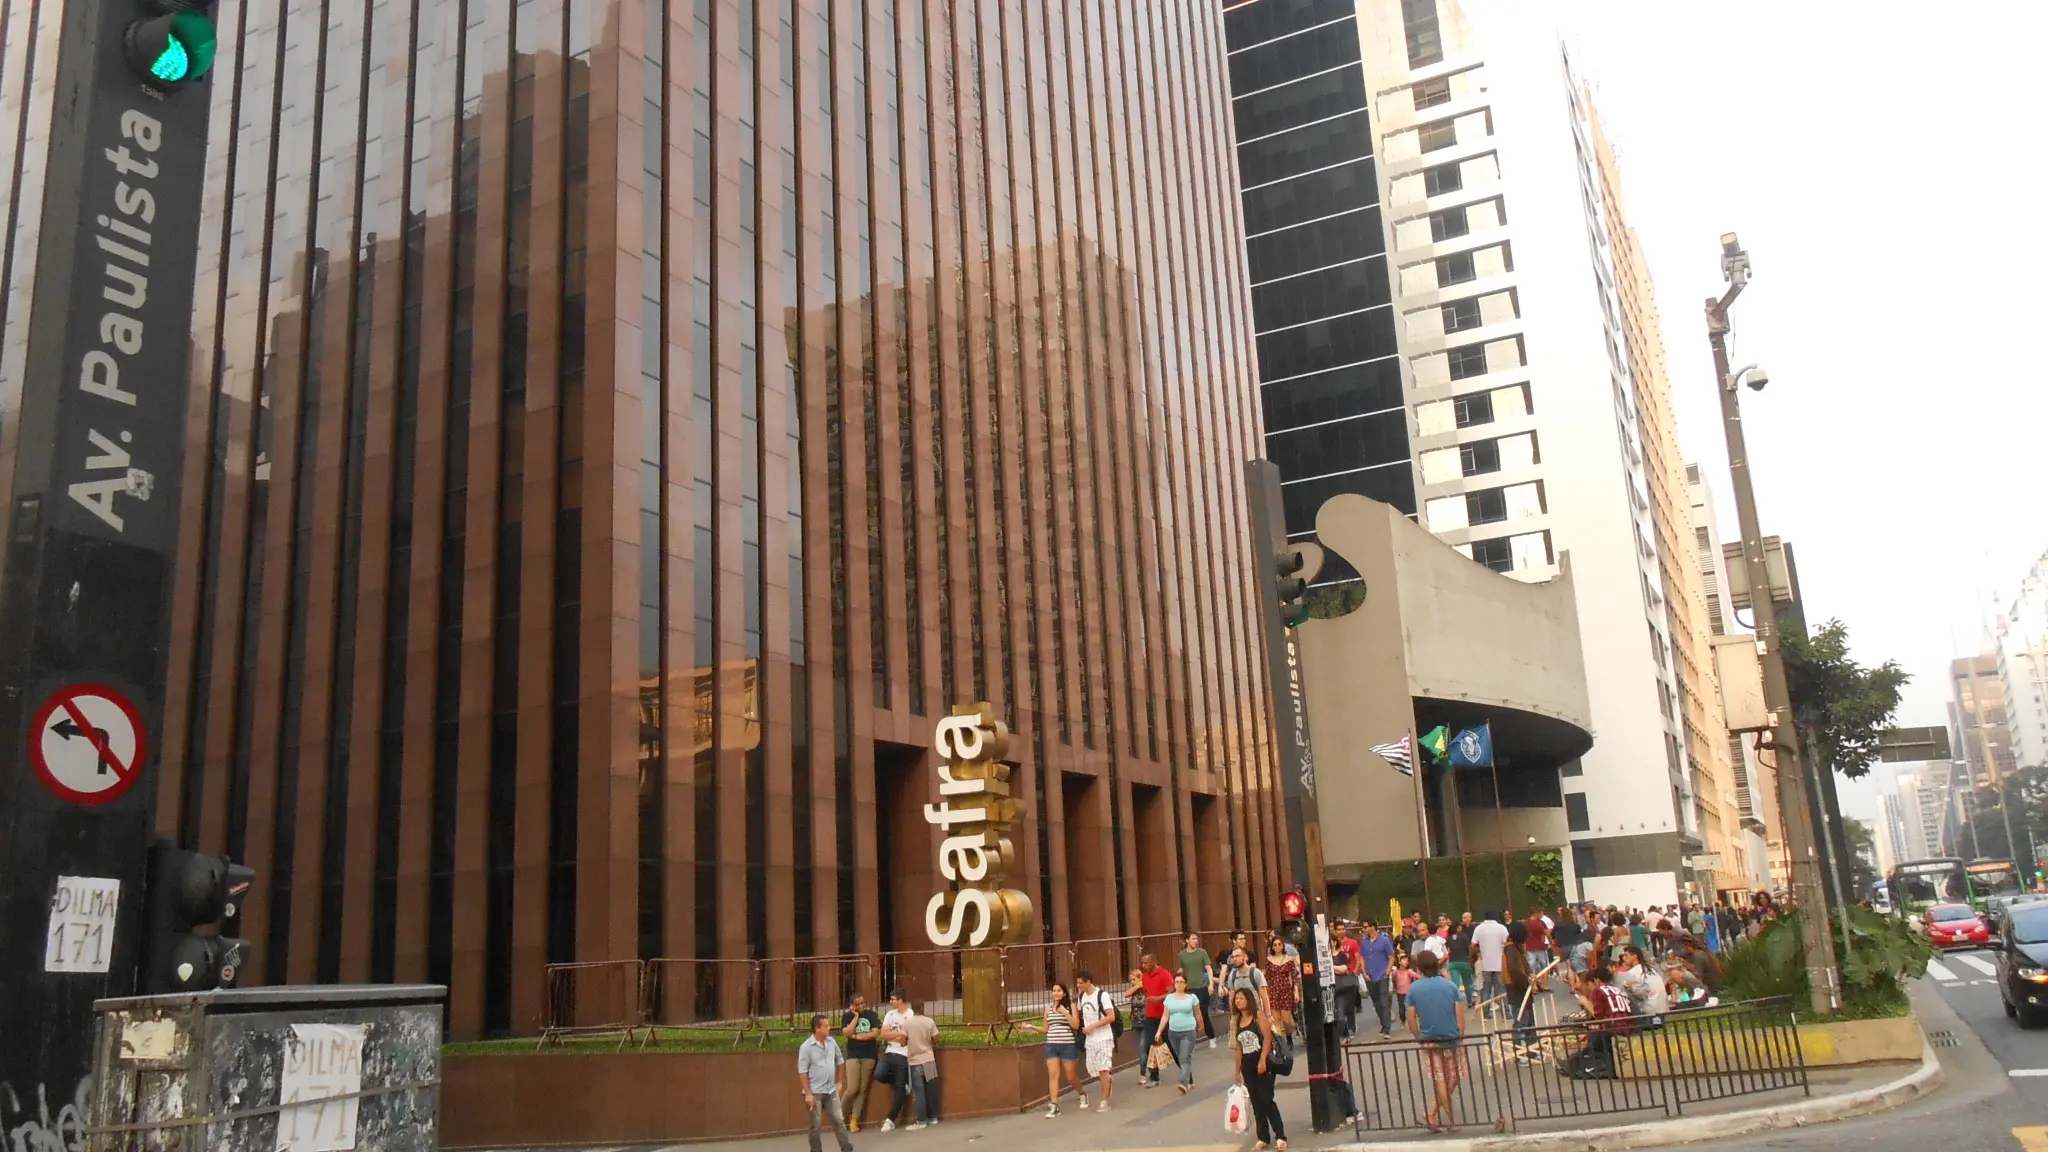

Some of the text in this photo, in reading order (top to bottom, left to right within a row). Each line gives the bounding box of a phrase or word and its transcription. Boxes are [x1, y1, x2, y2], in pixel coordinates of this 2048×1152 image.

[68, 108, 163, 533] Av. Paulista
[1287, 642, 1305, 747] Paulista
[923, 712, 991, 946] Safra
[56, 887, 115, 918] DILMA
[54, 922, 103, 965] 171
[287, 1037, 362, 1077] DILMA
[286, 1084, 348, 1142] 171
